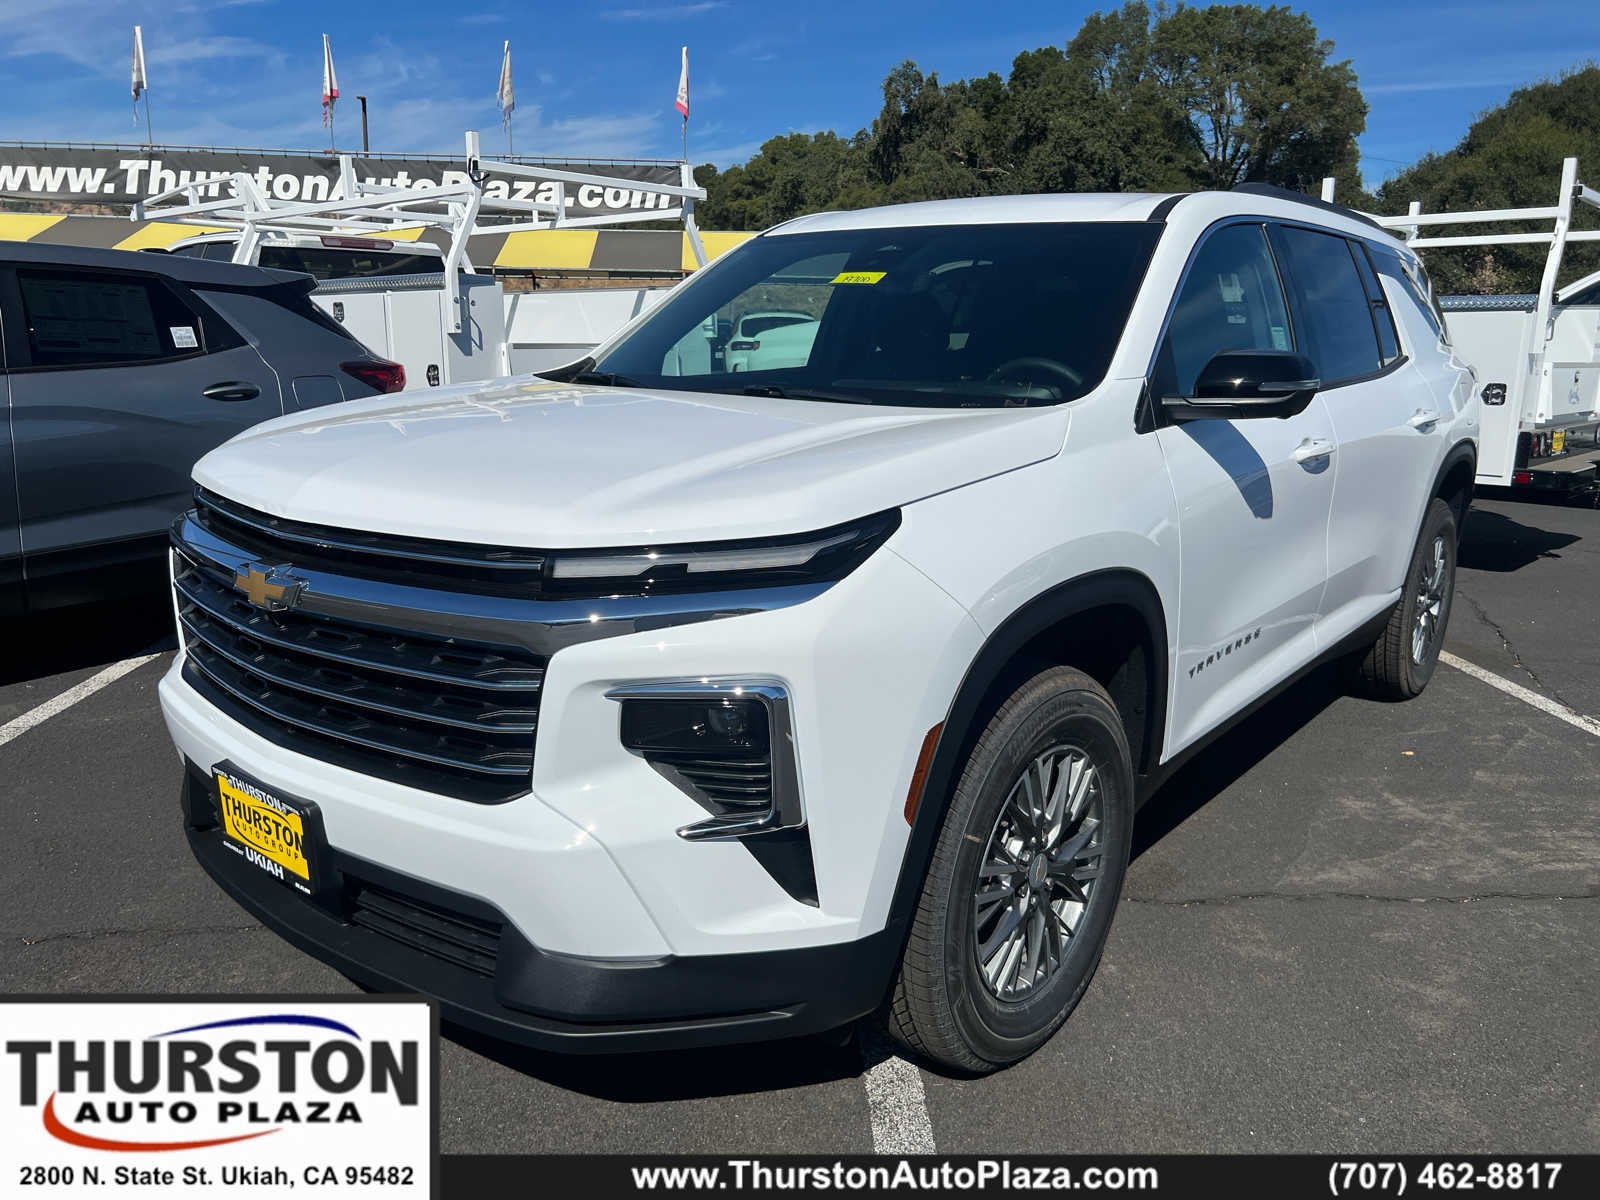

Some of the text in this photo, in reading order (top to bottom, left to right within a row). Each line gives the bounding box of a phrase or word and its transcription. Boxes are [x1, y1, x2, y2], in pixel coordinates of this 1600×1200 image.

[0, 159, 671, 209] www.ThurtonAtoPaza.com
[1189, 627, 1261, 679] TRAVERSE
[230, 775, 284, 812] THURSTON
[223, 793, 303, 851] THURSTON
[245, 846, 285, 880] UKIAH
